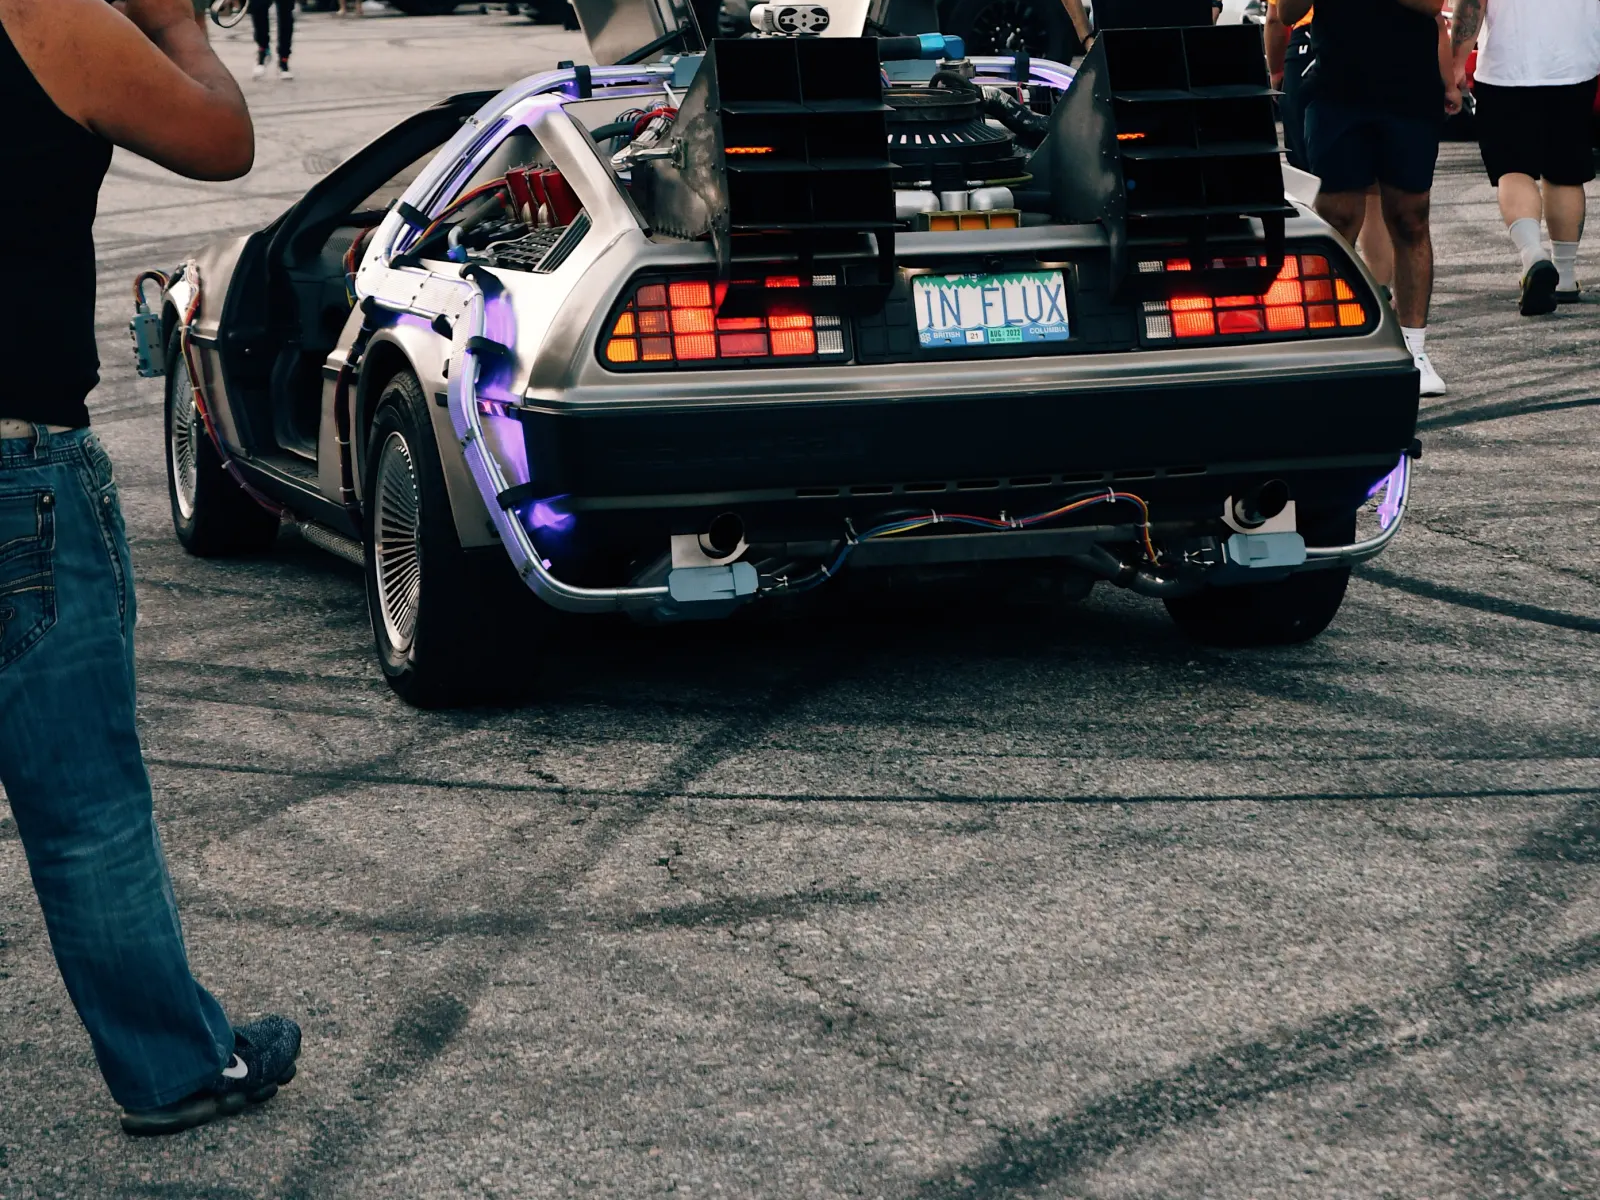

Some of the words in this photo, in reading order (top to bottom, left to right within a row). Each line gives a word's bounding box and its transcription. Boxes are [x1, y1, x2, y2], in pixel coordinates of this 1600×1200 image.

[924, 289, 962, 327] IN
[981, 283, 1065, 325] FLUX
[933, 331, 961, 339] BRITISH
[990, 330, 1002, 338] AUG
[1006, 329, 1021, 337] 2022
[1029, 326, 1067, 335] COLUMBIA
